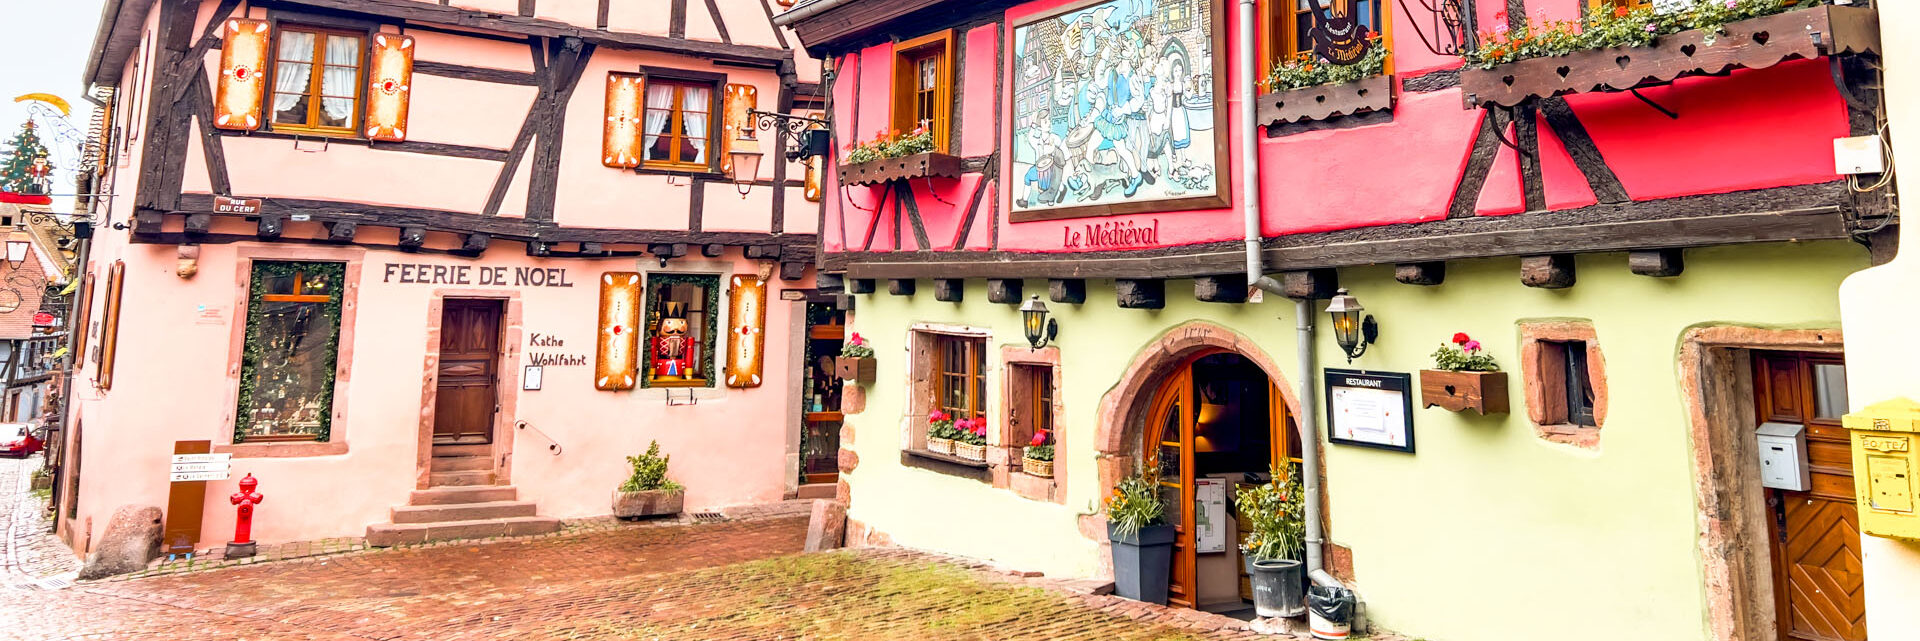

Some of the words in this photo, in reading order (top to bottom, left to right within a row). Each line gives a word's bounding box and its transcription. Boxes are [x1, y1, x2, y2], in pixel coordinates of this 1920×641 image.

[1064, 226, 1080, 248] Le
[1085, 218, 1160, 248] Médiéval
[383, 263, 471, 285] FEERIE
[479, 266, 508, 286] DE
[514, 267, 574, 288] NOEL
[529, 333, 564, 347] Kathe
[529, 352, 587, 367] Wohlfahrt
[1345, 377, 1382, 388] RESTAURANT
